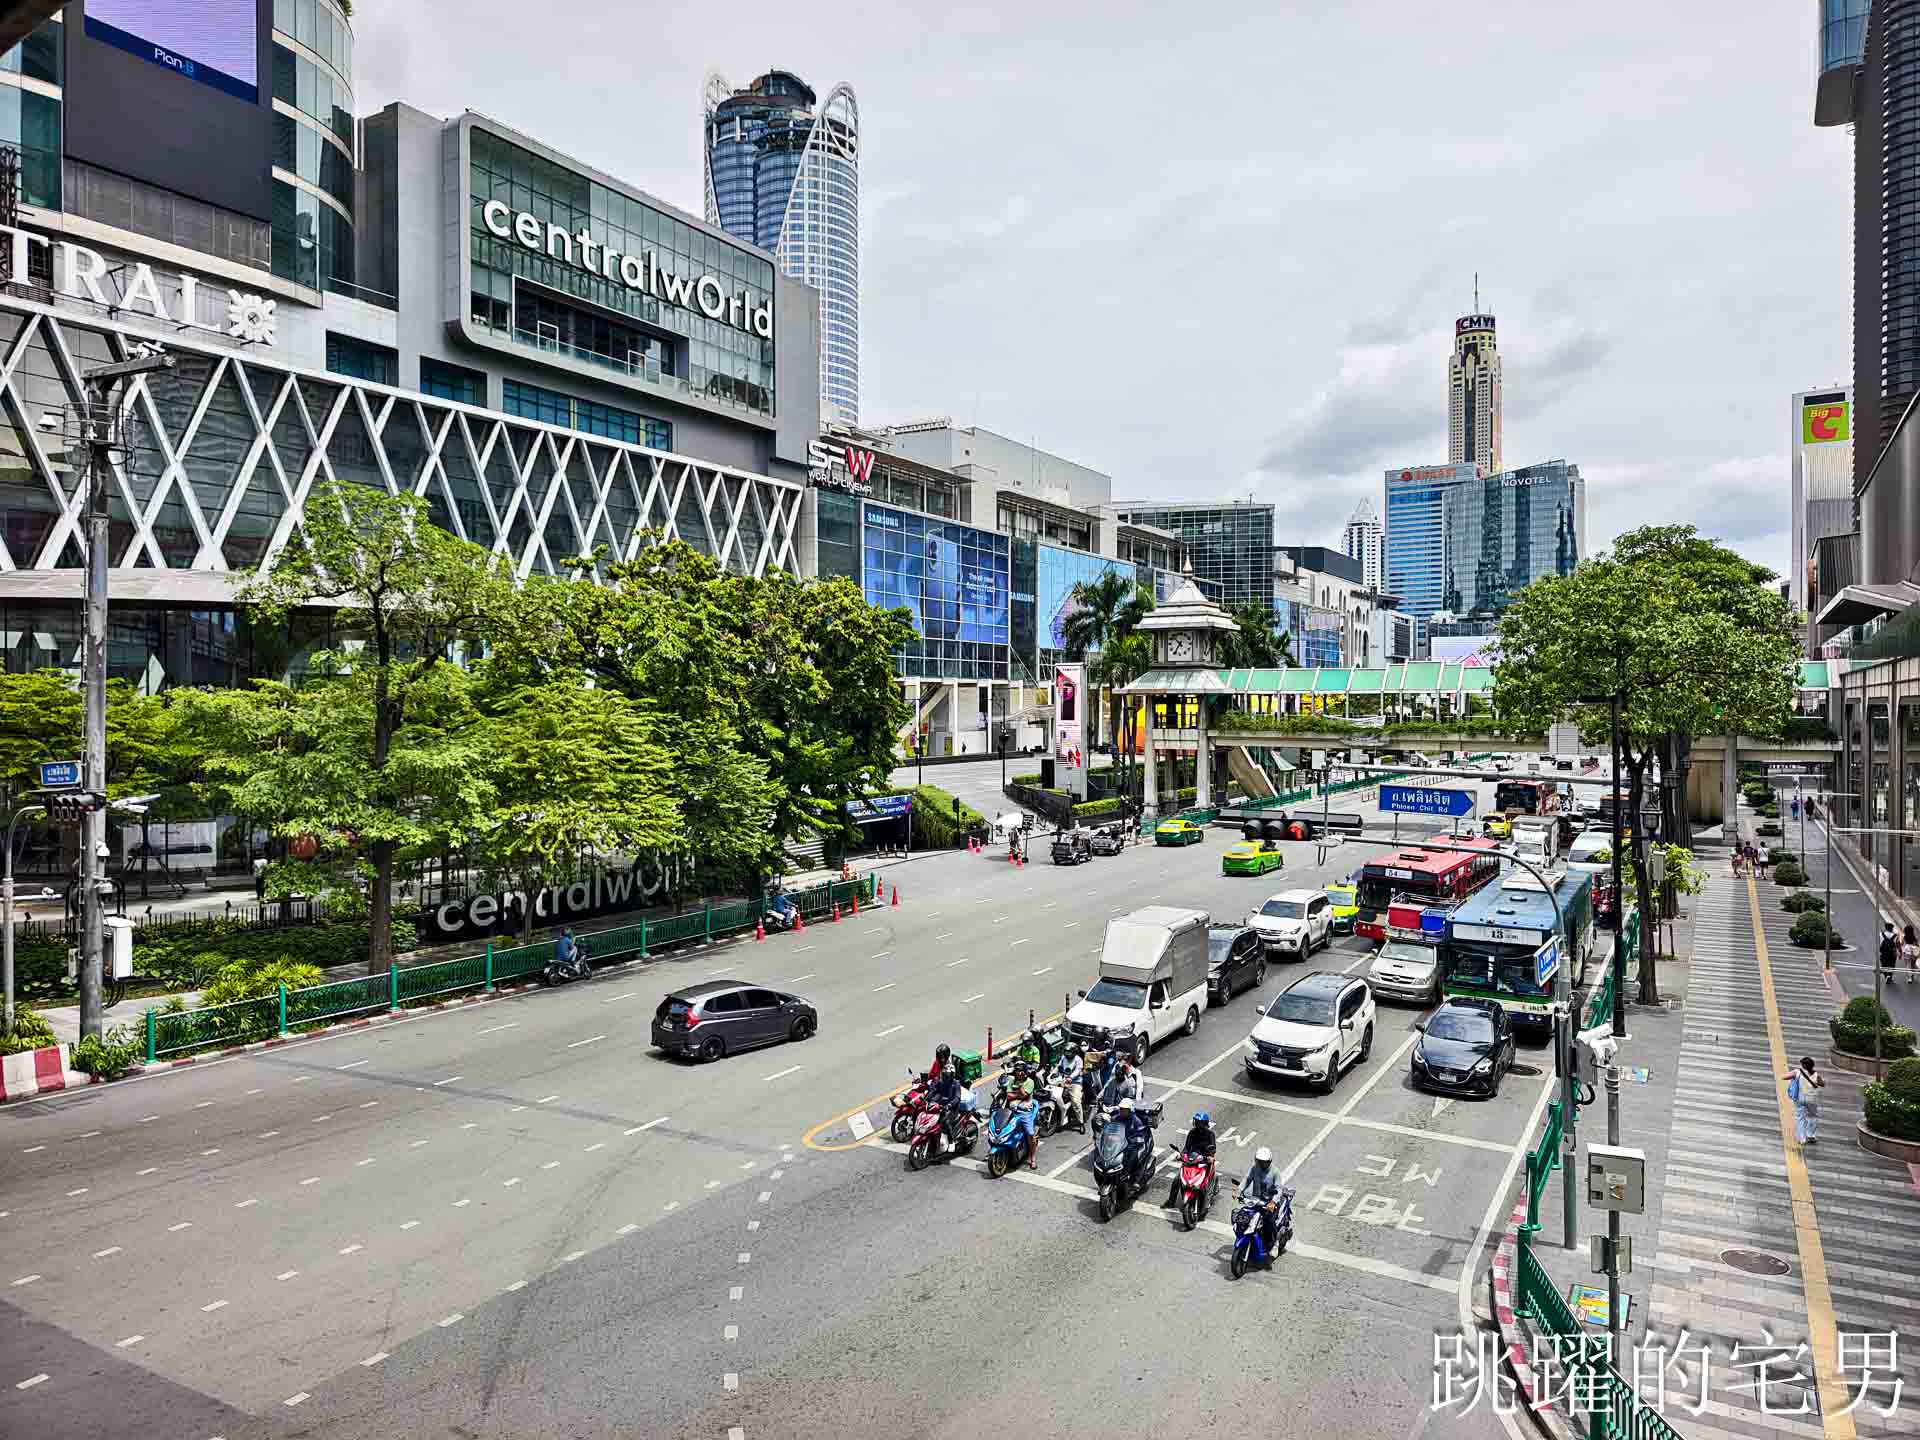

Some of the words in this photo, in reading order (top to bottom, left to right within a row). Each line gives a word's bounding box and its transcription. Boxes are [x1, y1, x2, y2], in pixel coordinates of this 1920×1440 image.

[154, 47, 183, 69] Plan
[483, 199, 772, 339] centralwOrld
[1809, 408, 1830, 418] Big
[1811, 406, 1843, 439] C
[808, 470, 839, 486] WORLD
[1501, 475, 1552, 487] NOVOTEL
[867, 512, 899, 528] SAMSUNG
[1419, 804, 1433, 812] Chit
[1491, 929, 1504, 939] 13
